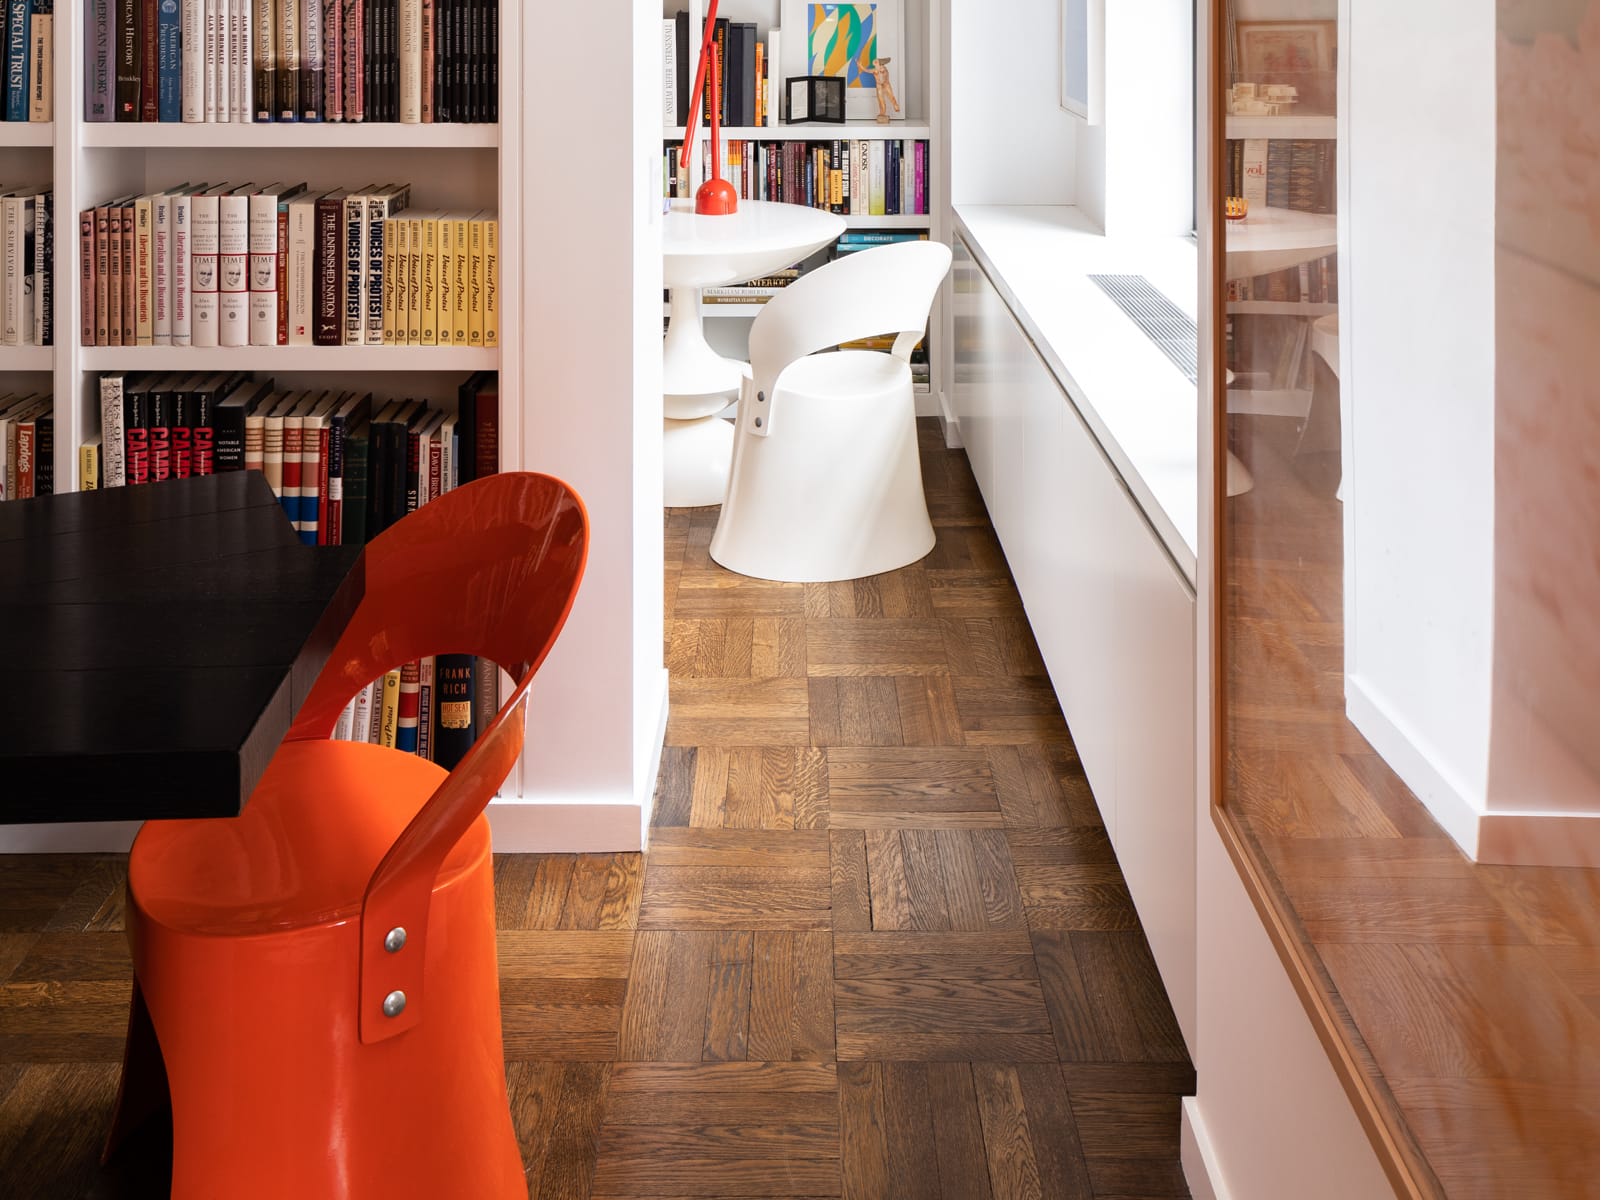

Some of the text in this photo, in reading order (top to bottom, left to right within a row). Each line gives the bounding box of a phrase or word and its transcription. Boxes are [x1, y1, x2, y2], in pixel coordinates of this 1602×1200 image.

[10, 3, 26, 90] SPECIAL TRUST
[97, 49, 108, 97] HISTORY
[7, 230, 15, 278] SURVIVOR
[176, 205, 186, 321] Brinkley Liberalism and its Discontents
[326, 213, 335, 318] THE UNFINISHED NATION
[369, 221, 382, 318] VOICES OF PROTEST
[486, 254, 496, 277] Voices
[486, 285, 496, 312] Protest
[18, 430, 31, 473] Lapdogs
[113, 385, 122, 480] EYES OF THE
[440, 667, 471, 679] FRANK
[443, 684, 467, 694] RICH
[442, 703, 469, 714] HOT SEAT
